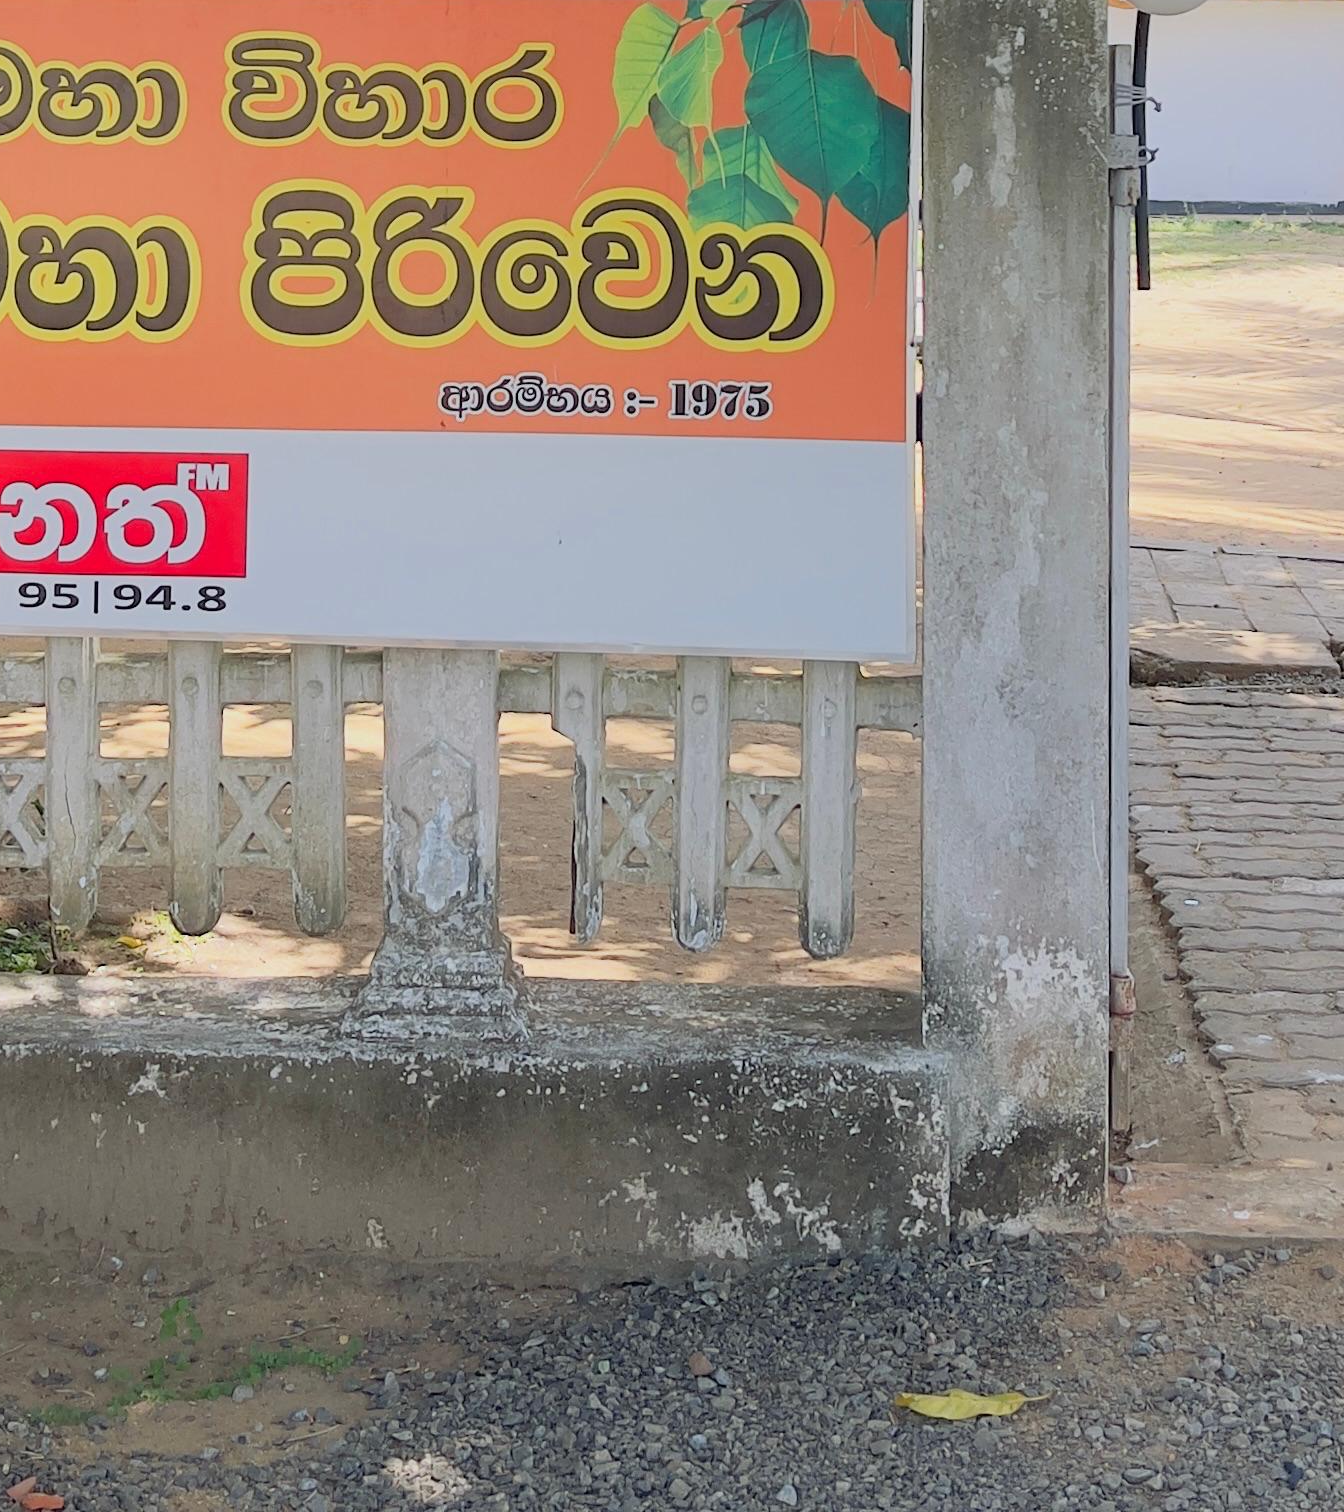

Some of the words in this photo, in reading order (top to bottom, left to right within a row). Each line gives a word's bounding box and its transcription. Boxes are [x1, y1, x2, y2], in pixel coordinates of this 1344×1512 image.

[222, 31, 563, 149] විහාර
[239, 178, 836, 353] පිරිවෙන
[439, 371, 613, 422] ආරම්භය
[668, 379, 773, 419] 1975
[176, 462, 231, 492] FM
